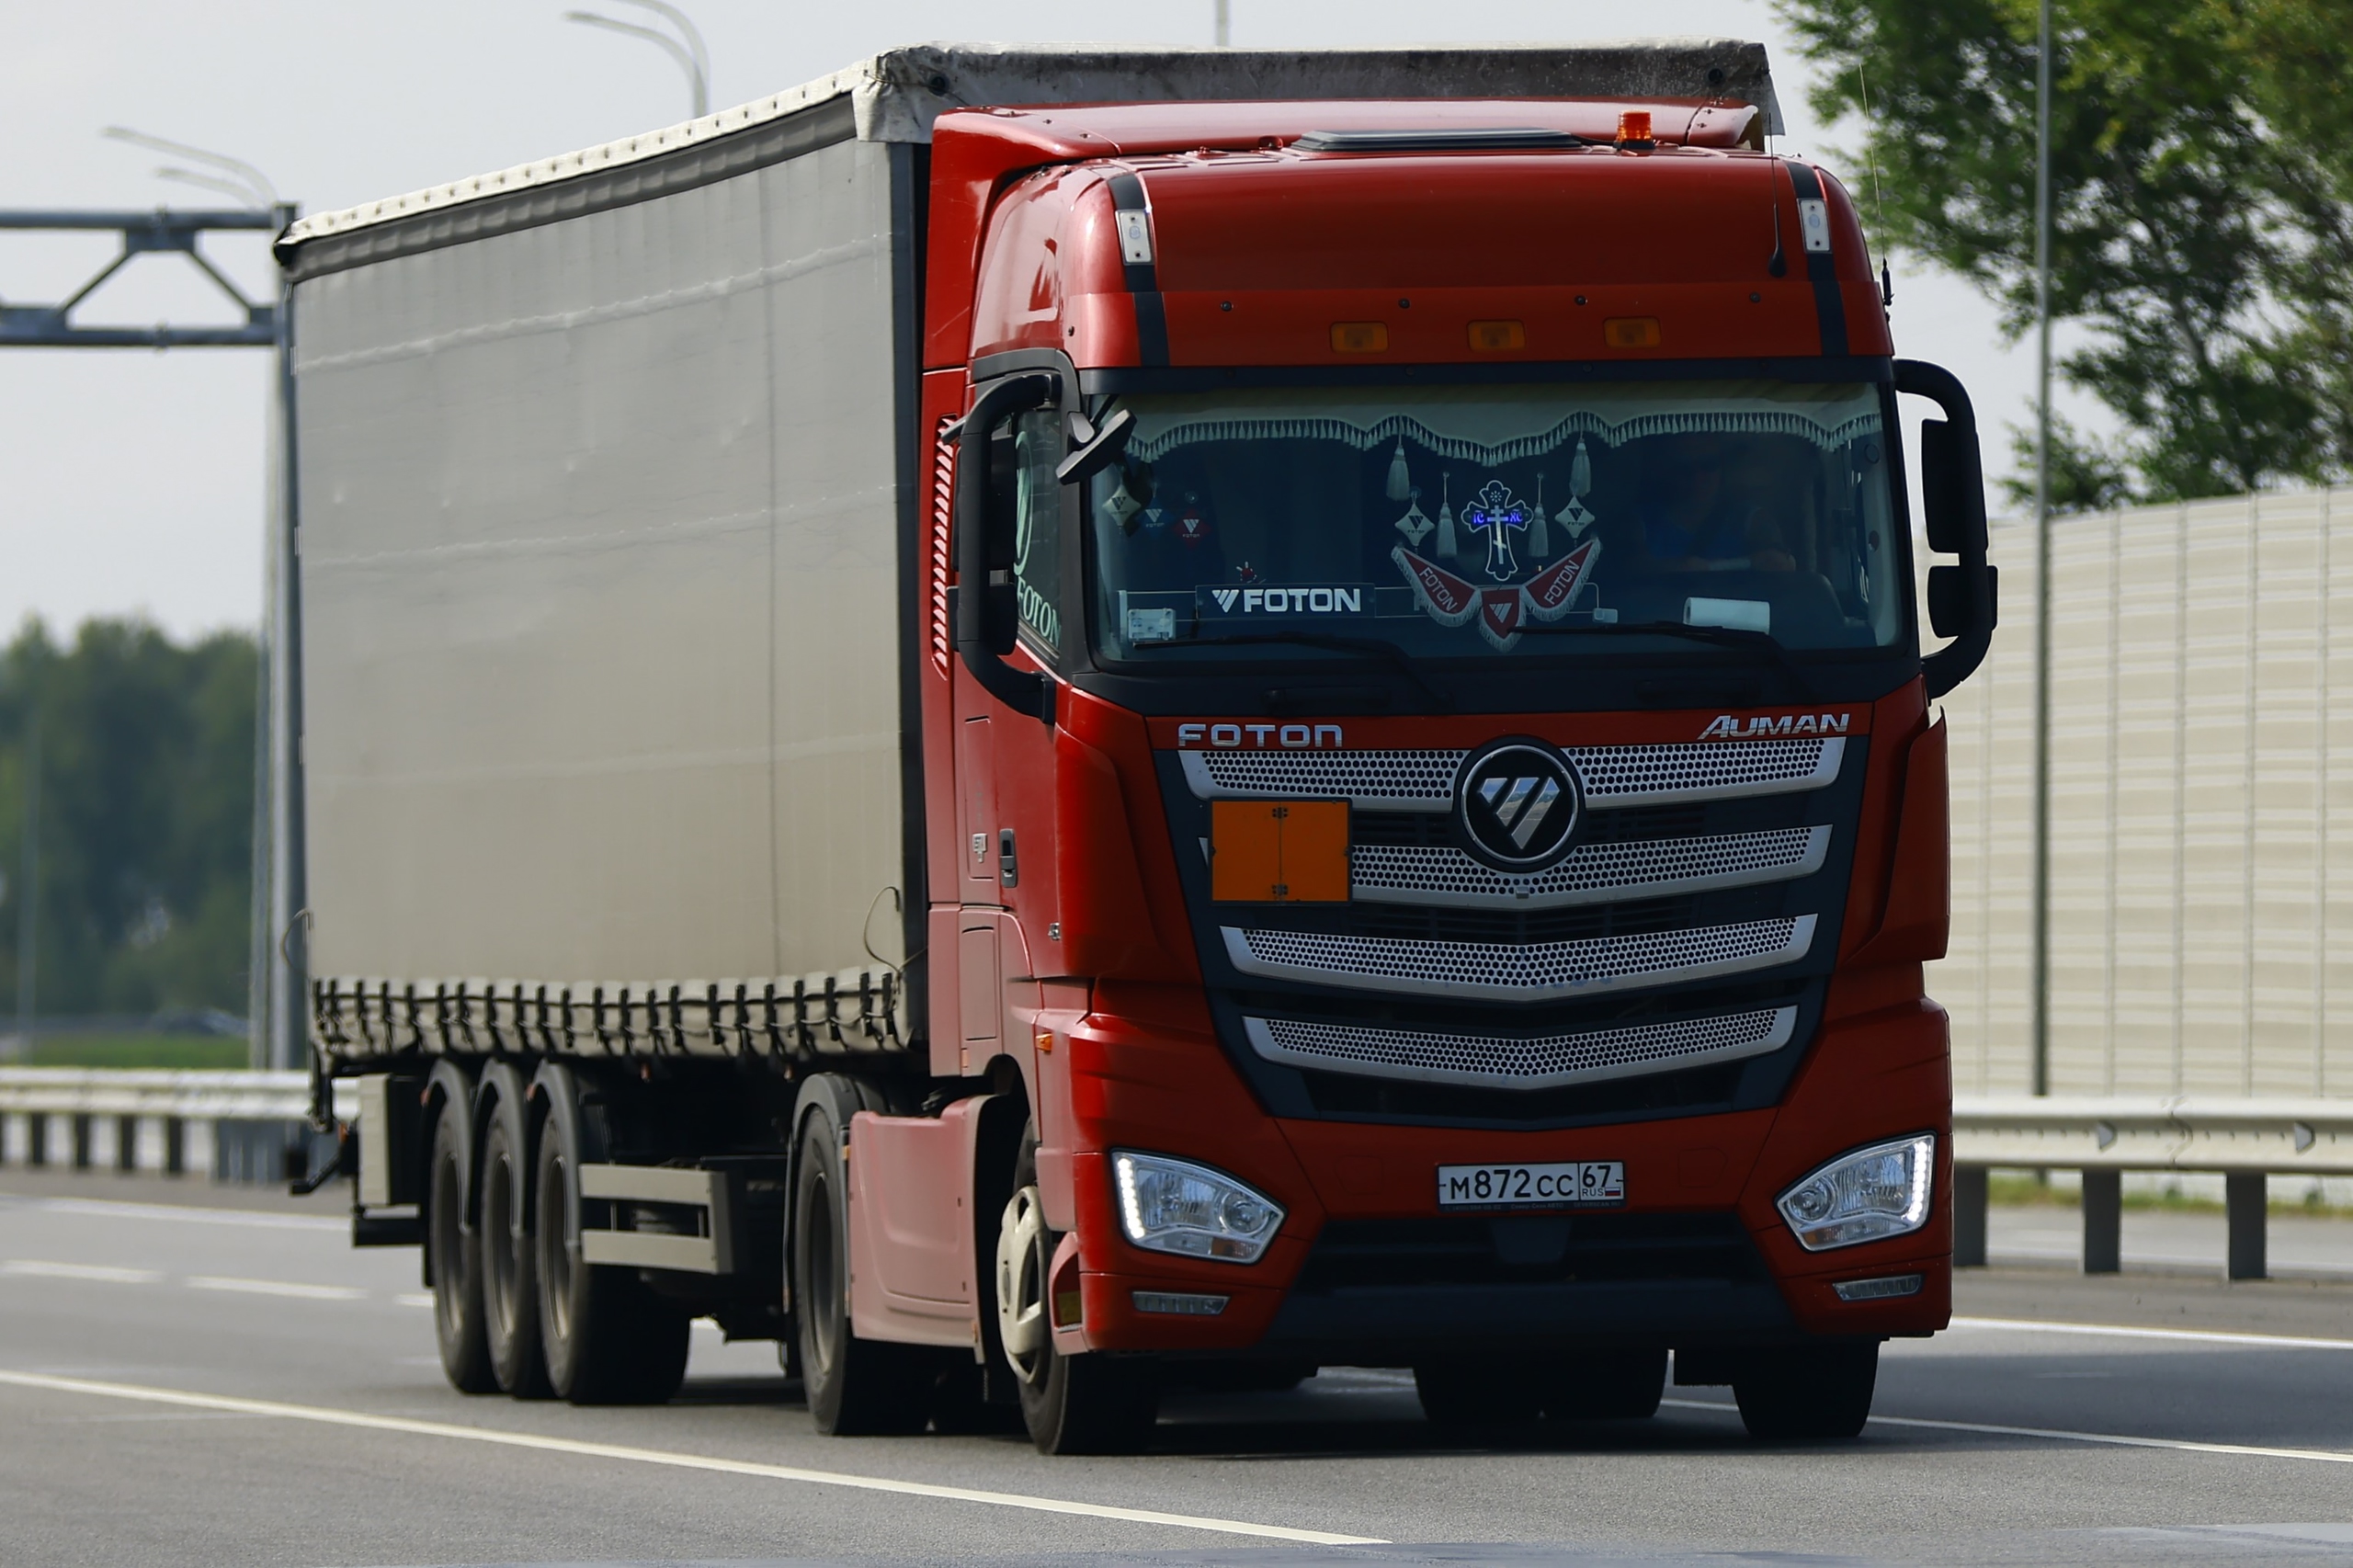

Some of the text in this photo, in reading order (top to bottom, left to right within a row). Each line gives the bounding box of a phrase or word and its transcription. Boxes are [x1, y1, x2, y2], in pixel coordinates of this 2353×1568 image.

[1419, 566, 1458, 612] FOTON
[1543, 559, 1581, 606] FOTON
[1244, 588, 1361, 613] FOTON
[1177, 723, 1343, 747] FOTON
[1697, 713, 1850, 740] AUMAN
[1582, 1165, 1612, 1188] 67
[1581, 1187, 1604, 1198] RUS
